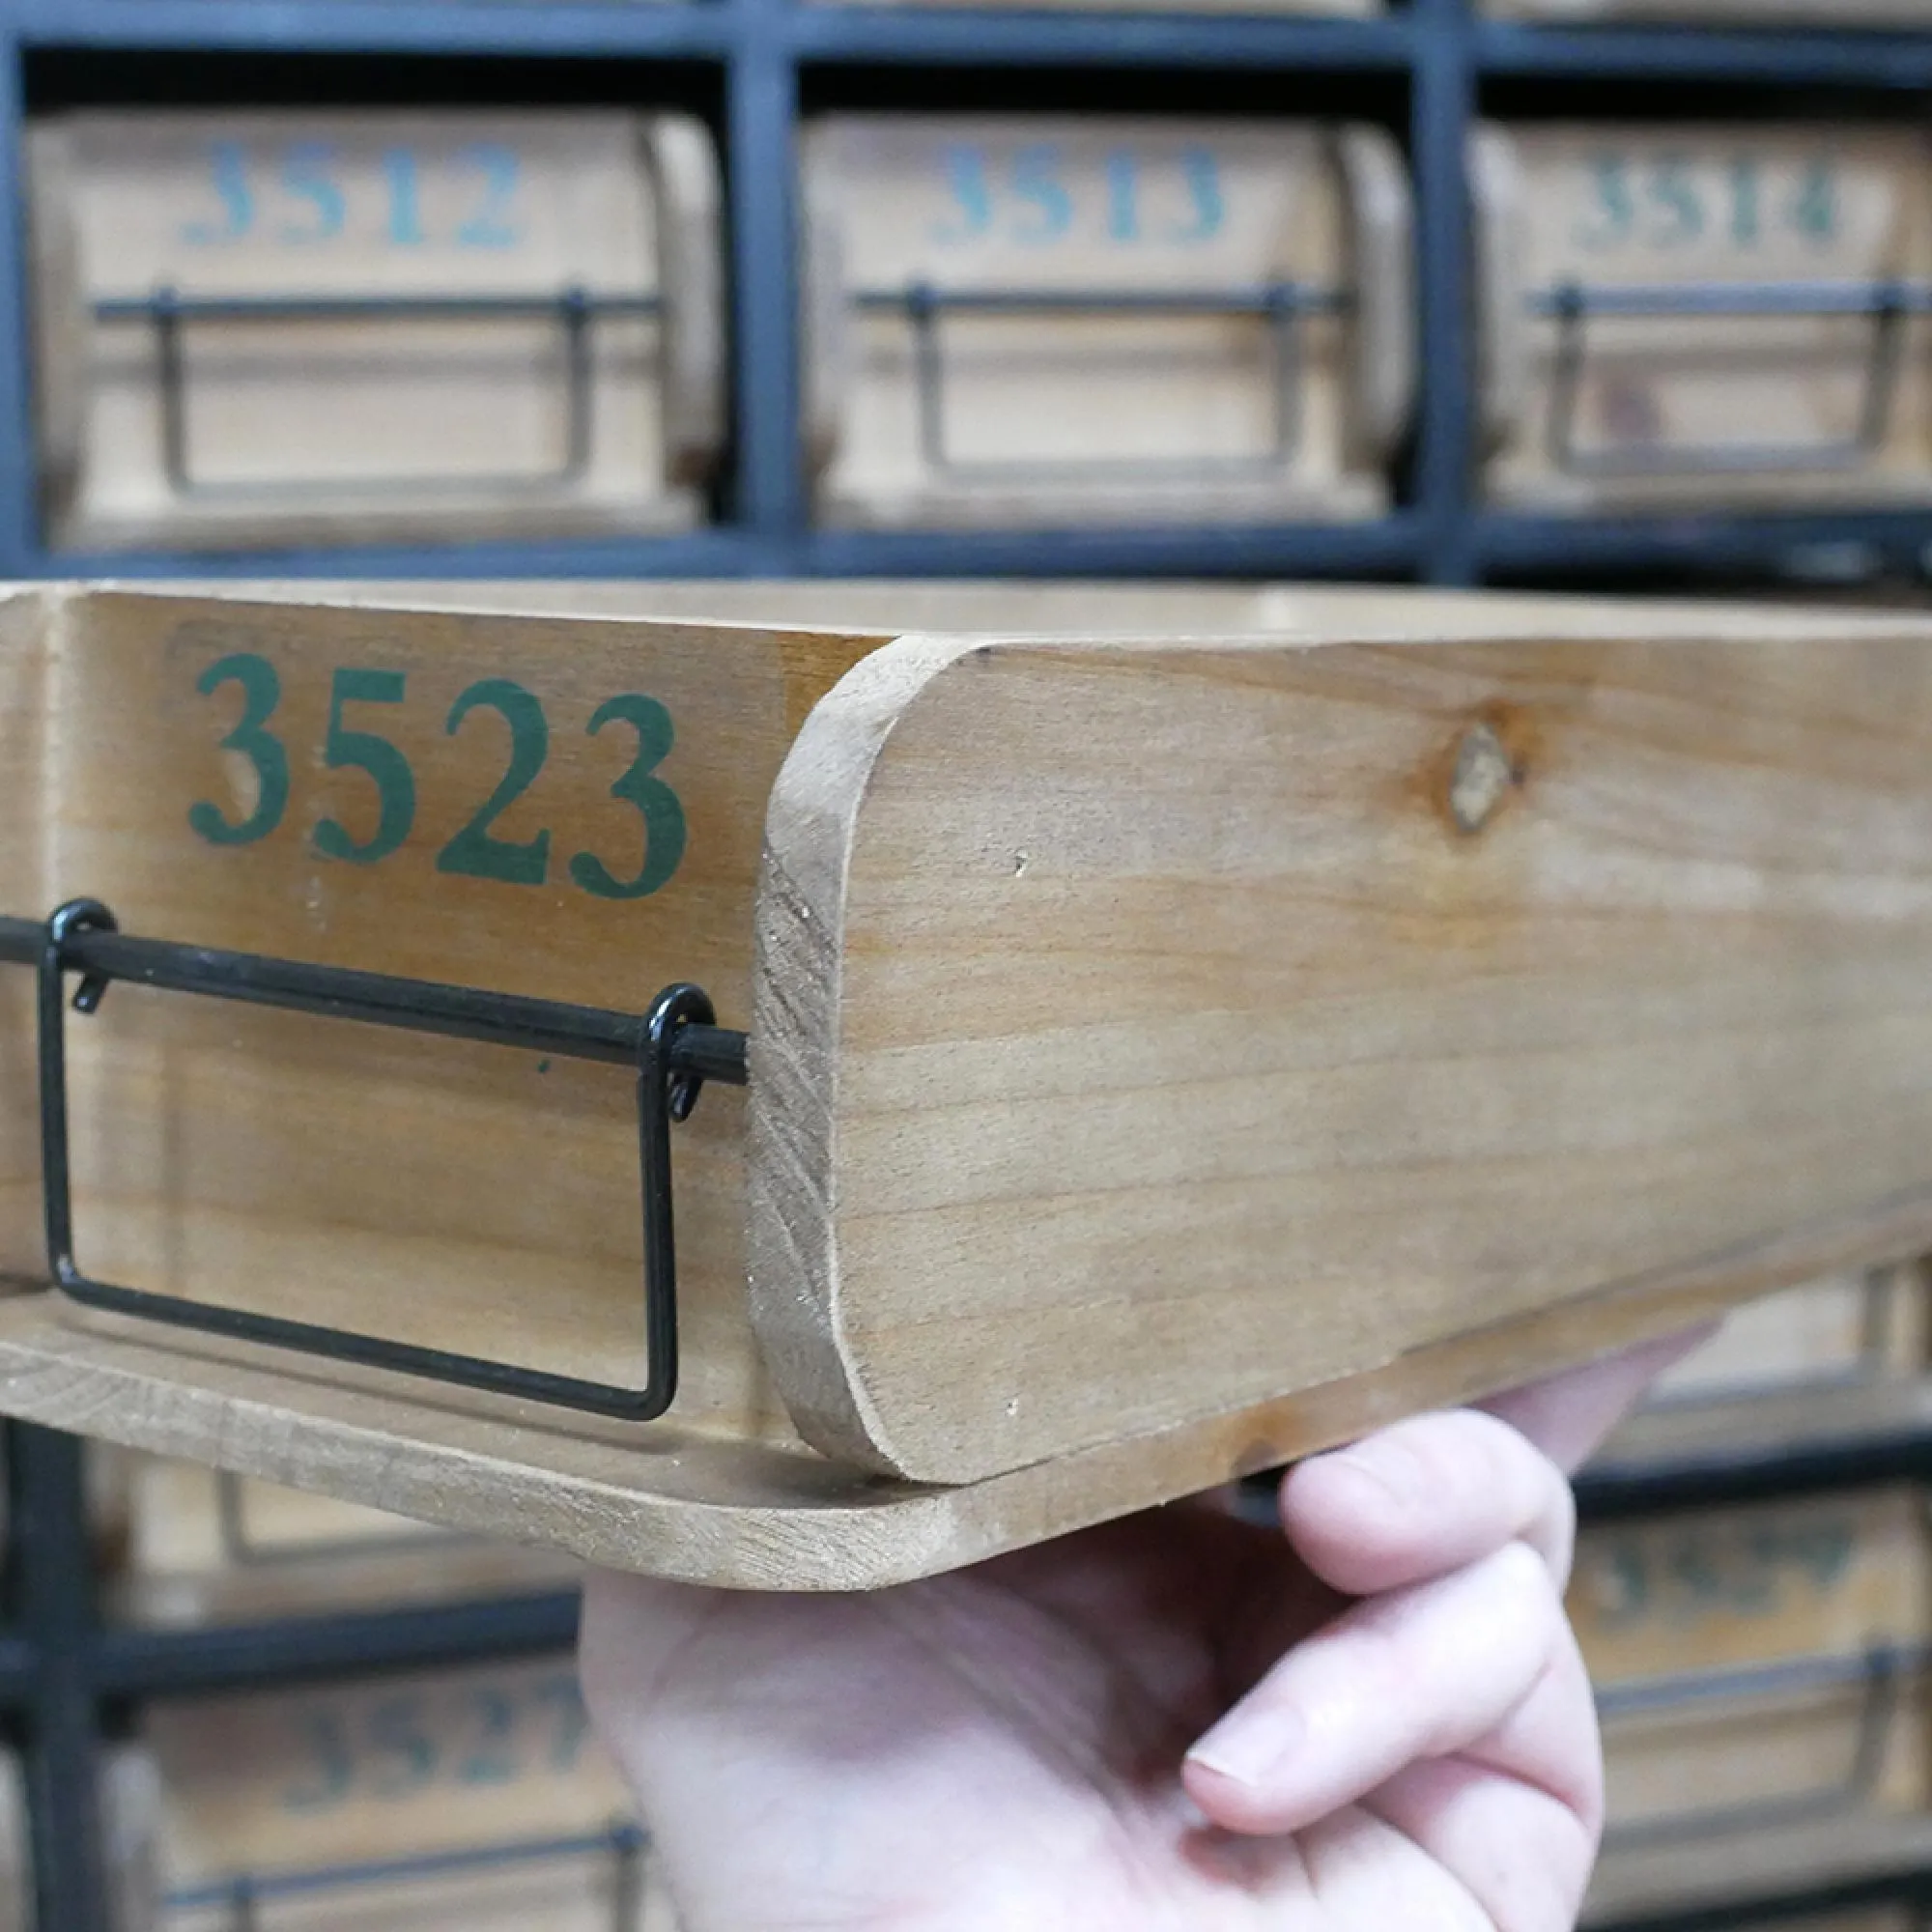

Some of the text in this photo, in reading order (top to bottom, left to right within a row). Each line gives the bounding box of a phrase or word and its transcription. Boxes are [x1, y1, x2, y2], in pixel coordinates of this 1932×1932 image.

[181, 140, 522, 247] 3512
[929, 142, 1229, 244] 3513
[188, 653, 687, 900] 3523
